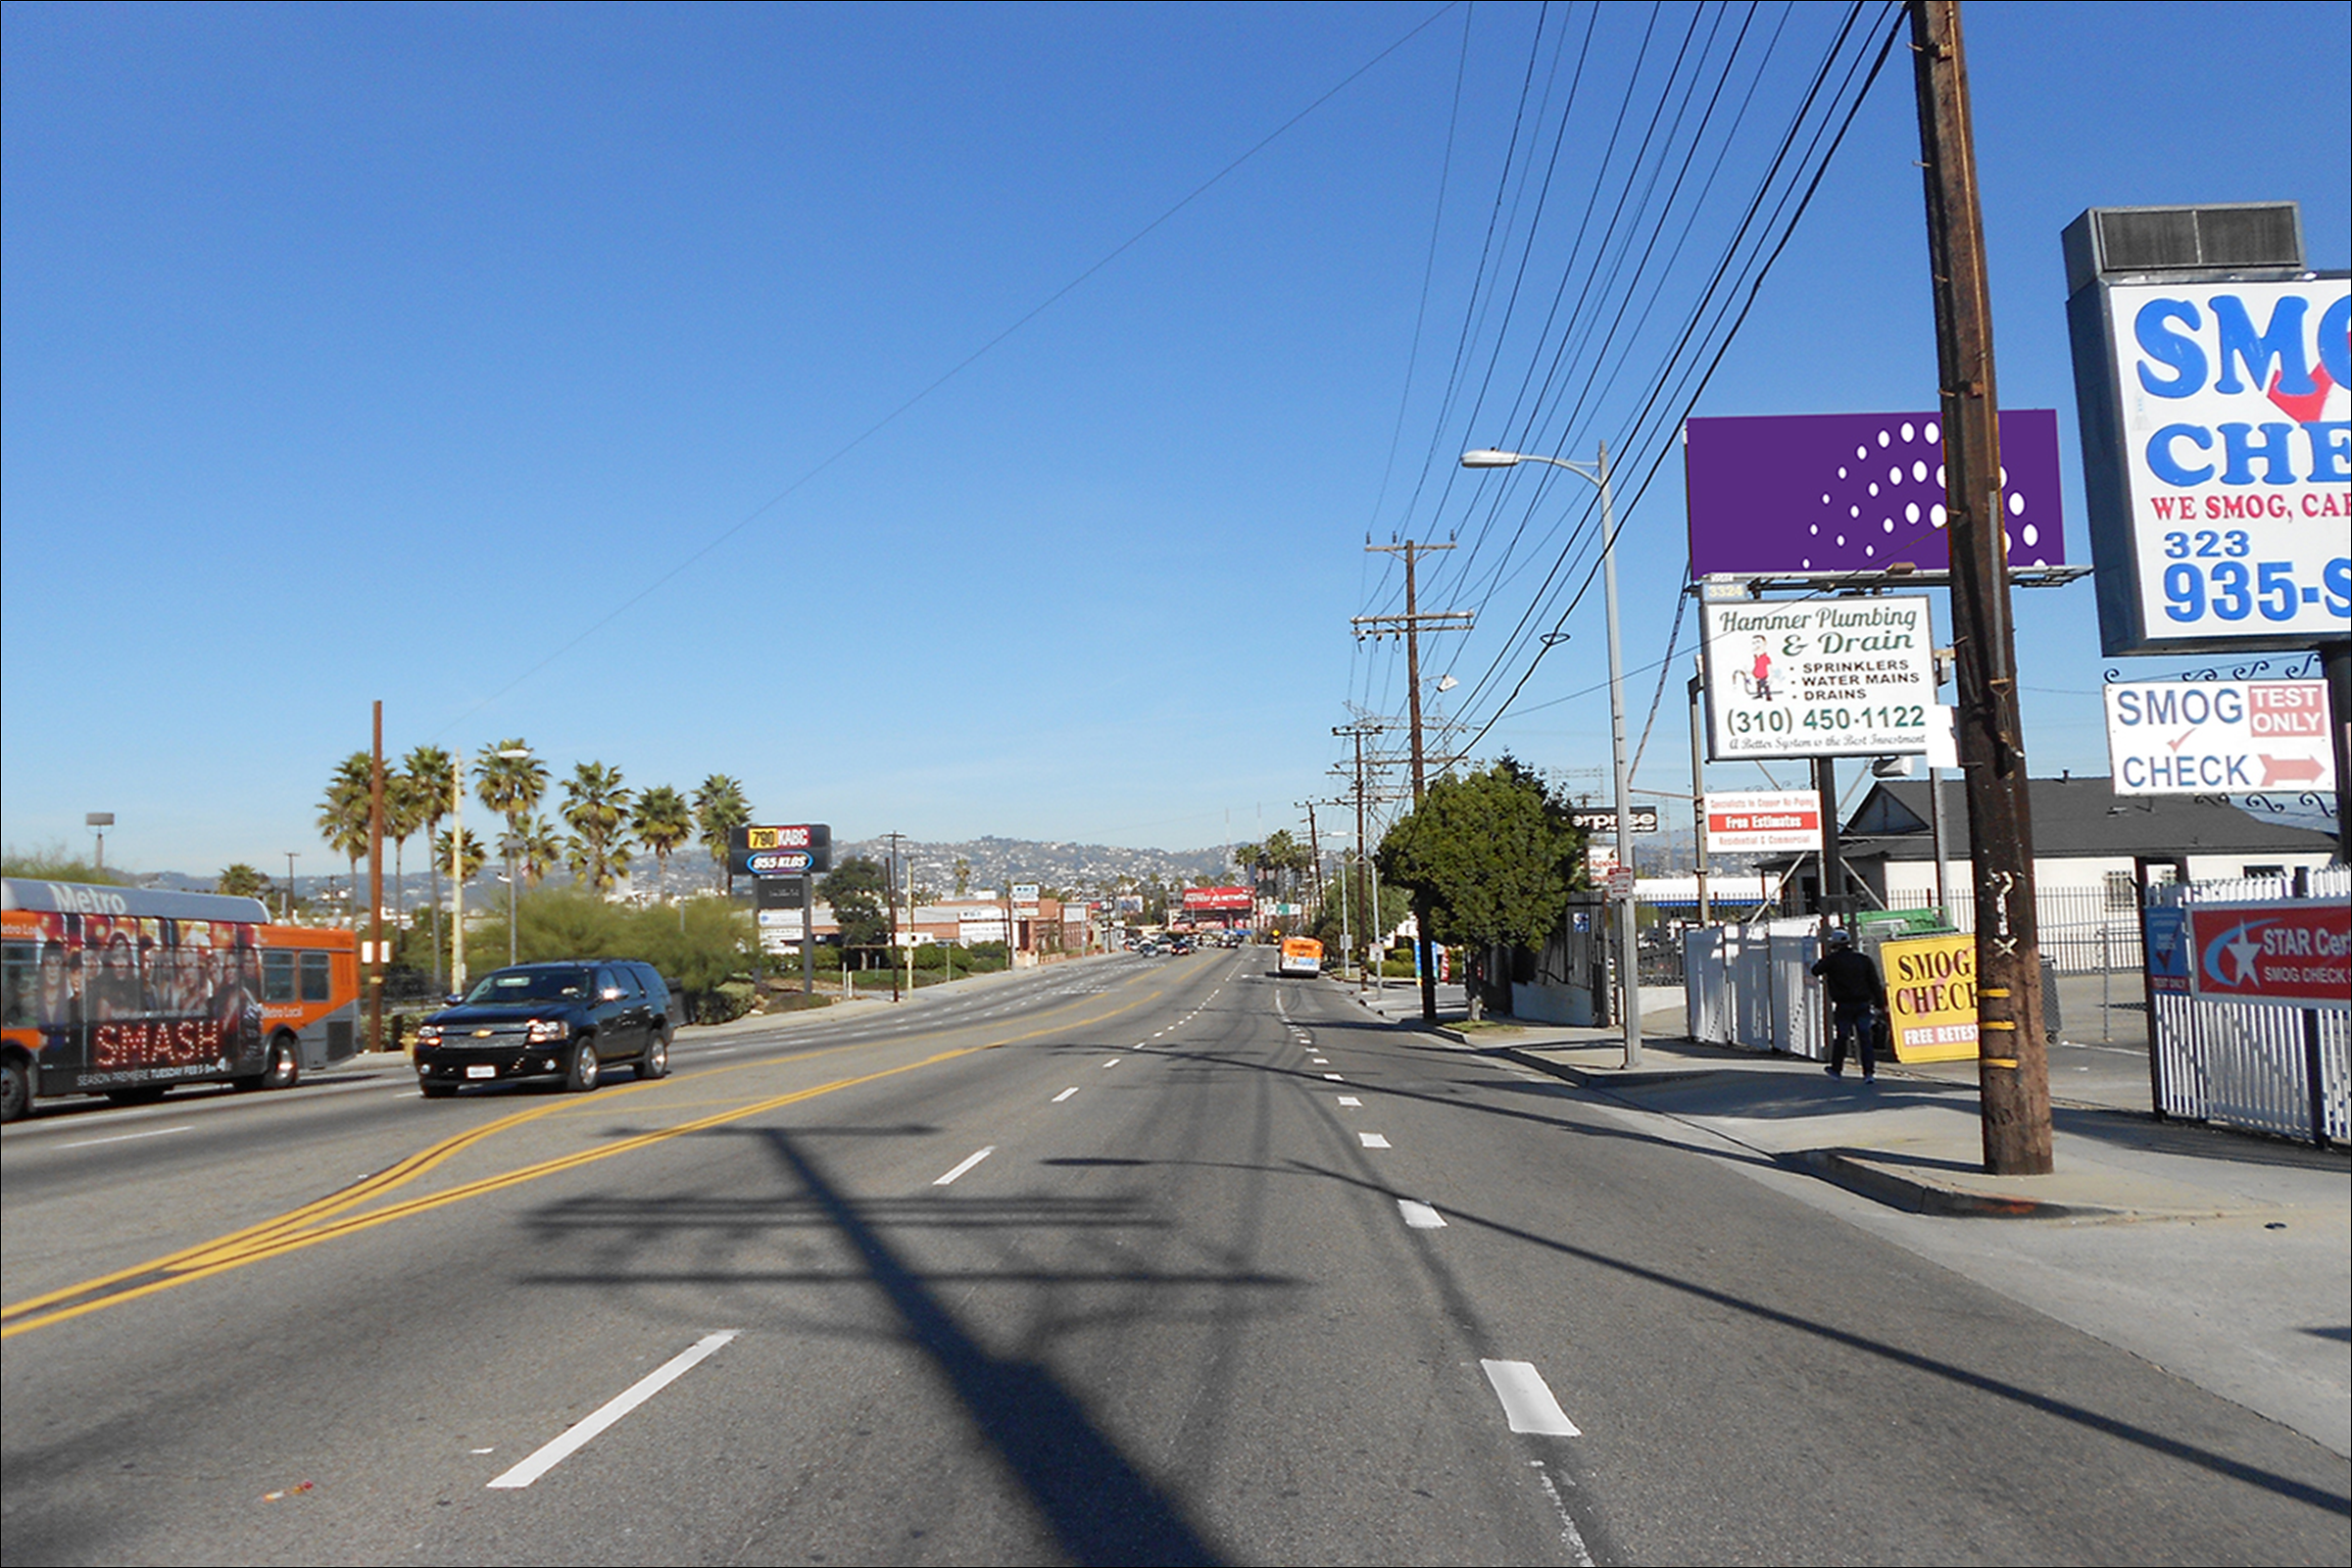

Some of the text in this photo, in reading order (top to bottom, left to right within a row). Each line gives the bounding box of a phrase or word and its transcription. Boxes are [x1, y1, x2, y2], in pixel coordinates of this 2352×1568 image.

[2150, 496, 2196, 520] WE
[2205, 494, 2293, 523] SMOG,
[2164, 529, 2250, 559] 323
[1708, 585, 1743, 598] 3324
[2164, 558, 2351, 622] 935-S
[1719, 607, 1917, 632] Hammer Plumbing
[1783, 630, 1914, 657] & Drain
[1802, 660, 1909, 674] SPRINKLERS
[1801, 672, 1920, 687] WATER MAINS
[1804, 689, 1867, 701] DRAINS
[2251, 687, 2319, 708] TEST
[2117, 688, 2243, 726] SMOG
[1727, 707, 1793, 736] (310)
[2252, 712, 2322, 732] ONLY
[1729, 739, 1739, 750] A
[1740, 737, 1773, 750] Better
[1826, 735, 1840, 746] the
[2123, 754, 2252, 787] CHECK
[1726, 814, 1802, 829] Free Estimates
[752, 828, 808, 847] 790 KABC
[47, 883, 126, 914] Metro
[2263, 927, 2313, 956] STAR
[1897, 949, 1971, 982] SMOG
[2264, 966, 2300, 983] SMOG
[2302, 966, 2347, 984] CHECK
[97, 1020, 219, 1065] SMASH
[1904, 1027, 1935, 1046] FREE
[76, 1072, 111, 1087] SEASON
[150, 1065, 184, 1079] TUESDAY
